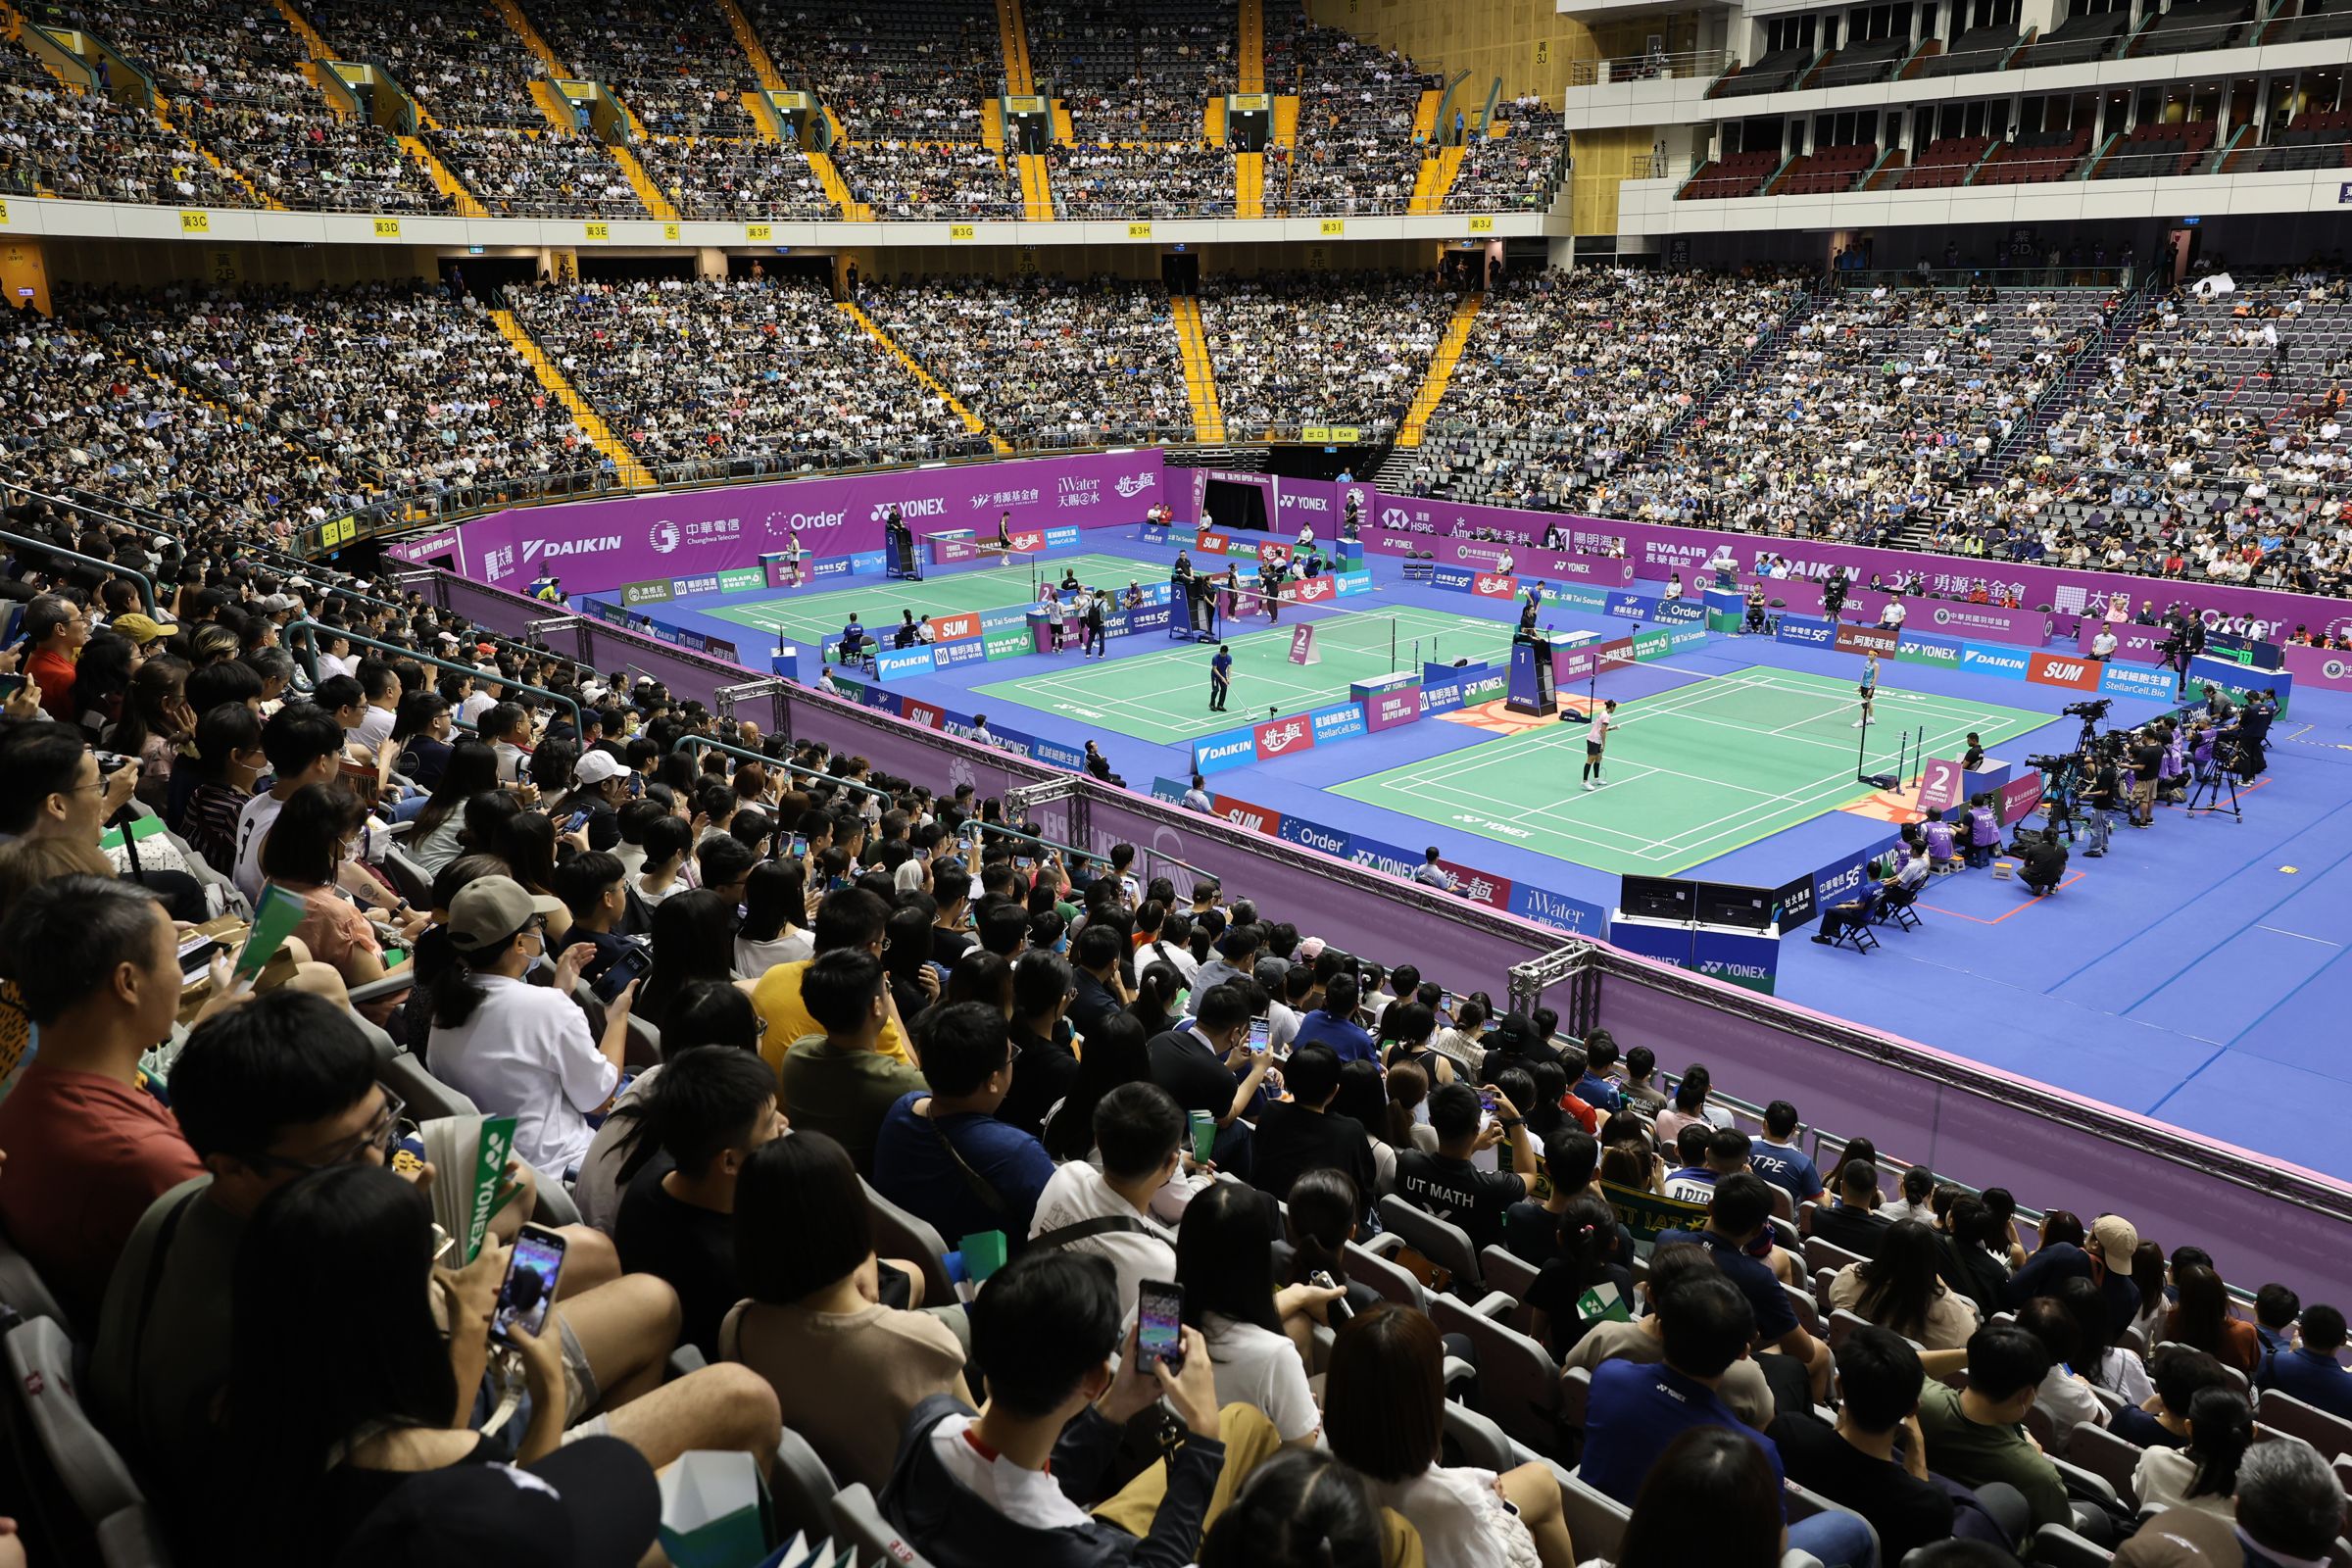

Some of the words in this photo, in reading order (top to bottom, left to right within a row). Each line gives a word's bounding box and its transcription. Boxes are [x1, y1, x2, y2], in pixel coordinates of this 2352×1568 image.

[1538, 41, 1546, 53] 黃
[1537, 53, 1547, 64] 3J
[181, 216, 208, 227] 黃3C
[375, 222, 398, 233] 黃3D
[1323, 221, 1343, 232] 黃3I
[1471, 220, 1492, 229] 黃3J
[586, 226, 608, 236] 黃3E
[667, 226, 676, 235] 北
[748, 227, 769, 237] 黃3F
[952, 227, 973, 237] 黃3G
[1129, 226, 1151, 236] 黃3H
[558, 255, 569, 265] 黃
[1309, 259, 1325, 268] 2E
[1671, 252, 1688, 263] 2E
[1019, 263, 1036, 272] 2D
[1058, 476, 1100, 493] iWater
[993, 488, 1039, 504] 勇源基金會
[899, 498, 945, 517] YONEX
[1297, 496, 1327, 511] YONEX
[686, 517, 740, 537] 中華電信
[790, 510, 845, 531] Order
[1411, 521, 1434, 533] HSBC
[324, 527, 335, 540] 出口
[342, 522, 352, 534] Exit
[687, 536, 716, 546] Chunghwa
[716, 533, 740, 543] Telecom
[888, 536, 893, 545] 3
[1202, 537, 1221, 550] SUM
[1395, 539, 1413, 551] YONEX
[543, 536, 621, 558] DAIKIN
[1239, 543, 1256, 554] YONEX
[497, 545, 514, 569] 太報
[1645, 554, 1691, 567] 長榮航空
[835, 562, 847, 572] 5G
[1567, 563, 1591, 573] YONEX
[1783, 561, 1861, 582] DAIKN
[1455, 575, 1468, 587] 5G
[1041, 586, 1050, 602] 2
[1175, 589, 1181, 600] 2
[1572, 594, 1583, 604] Tai
[1583, 596, 1605, 607] Sounds
[1156, 612, 1170, 623] 5G
[1671, 605, 1701, 618] Order
[993, 617, 1004, 626] Tai
[1004, 614, 1027, 624] Sounds
[942, 619, 968, 637] SUM
[1783, 624, 1811, 636] 中華電信
[657, 629, 676, 643] DAIKIN
[1297, 628, 1306, 647] 2
[1688, 630, 1706, 640] Sounds
[1811, 629, 1828, 642] 5G
[949, 641, 982, 656] 陽明海運
[1636, 642, 1648, 651] EVA
[1647, 638, 1660, 647] AIR
[1853, 635, 1896, 651] 阿默蛋糕
[2241, 640, 2253, 651] 20
[952, 654, 968, 662] YANG
[969, 651, 983, 660] MING
[1519, 652, 1525, 664] 1
[1922, 644, 1956, 661] YONEX
[2241, 653, 2251, 662] 17
[891, 654, 930, 669] DAIKIN
[1568, 654, 1586, 666] YONEX
[1977, 654, 2026, 669] DAIKIN
[2043, 662, 2084, 682] SUM
[2107, 668, 2173, 687] 星誠細胞生醫
[1392, 680, 1407, 690] YONEX
[1479, 676, 1504, 693] YONEX
[2105, 681, 2166, 699] StellarCell.Bio
[1429, 685, 1459, 701] 陽明海運
[1382, 698, 1401, 711] YONEX
[910, 707, 934, 727] SUM
[1315, 707, 1361, 728] 星誠細胞生醫
[1382, 708, 1397, 721] TAIPEI
[1397, 706, 1412, 718] OPEN
[1261, 722, 1303, 752] 統一麵
[1317, 723, 1361, 741] StellarCell.Bio
[1004, 738, 1030, 757] YONEX
[1209, 740, 1252, 760] DAIKIN
[1037, 743, 1081, 766] 星誠細胞生醫
[1930, 765, 1950, 792] 2
[1168, 794, 1180, 806] Tai
[1924, 795, 1947, 804] interval
[1926, 790, 1948, 799] minutes
[1229, 808, 1264, 832] SUM
[1482, 820, 1536, 838] YONEX
[1300, 827, 1344, 854] Order
[1377, 855, 1418, 882] YONEX
[1819, 873, 1845, 894] 中華電信
[1845, 866, 1860, 890] 5G
[1527, 890, 1585, 924] iWater
[1798, 902, 1809, 913] Taipei
[1725, 962, 1766, 980] YONEX
[1753, 1153, 1788, 1174] TPE
[1406, 1175, 1427, 1193] UT
[1429, 1182, 1475, 1209] MATH
[468, 1176, 497, 1250] YONEX
[1667, 1388, 1687, 1403] YONEX
